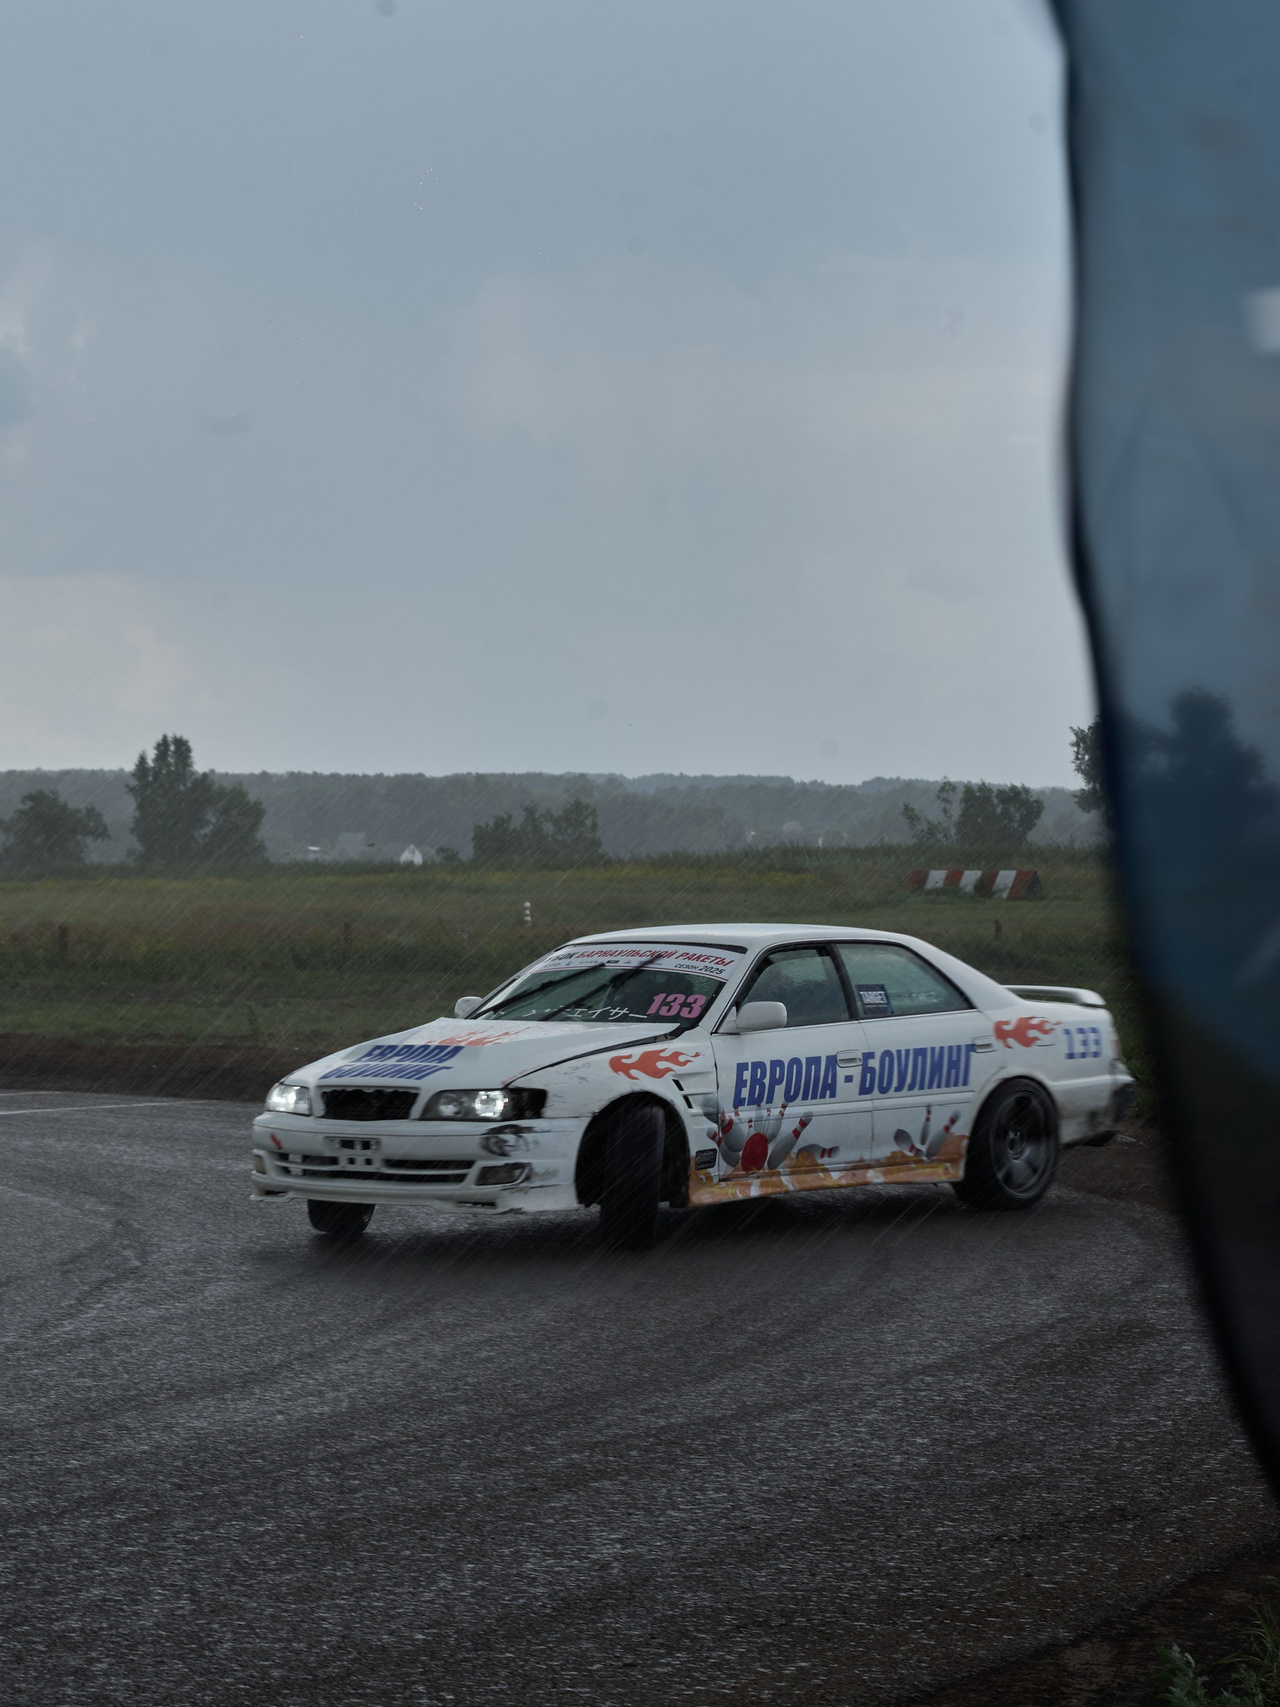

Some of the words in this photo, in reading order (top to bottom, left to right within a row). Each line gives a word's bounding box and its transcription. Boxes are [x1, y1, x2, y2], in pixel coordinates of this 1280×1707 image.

[575, 949, 678, 960] БАРНАУЛЬСКОЙ
[674, 951, 735, 967] РАКЕТЫ
[674, 963, 699, 971] СЕЗОН
[698, 965, 726, 975] 2025
[646, 992, 707, 1018] 133
[1063, 1027, 1102, 1060] 133
[352, 1044, 465, 1063] ЕВРОПА
[319, 1063, 454, 1081] БОУЛИНГ
[733, 1055, 838, 1107] ЕВРОПА
[858, 1043, 976, 1096] БОУЛИНГ
